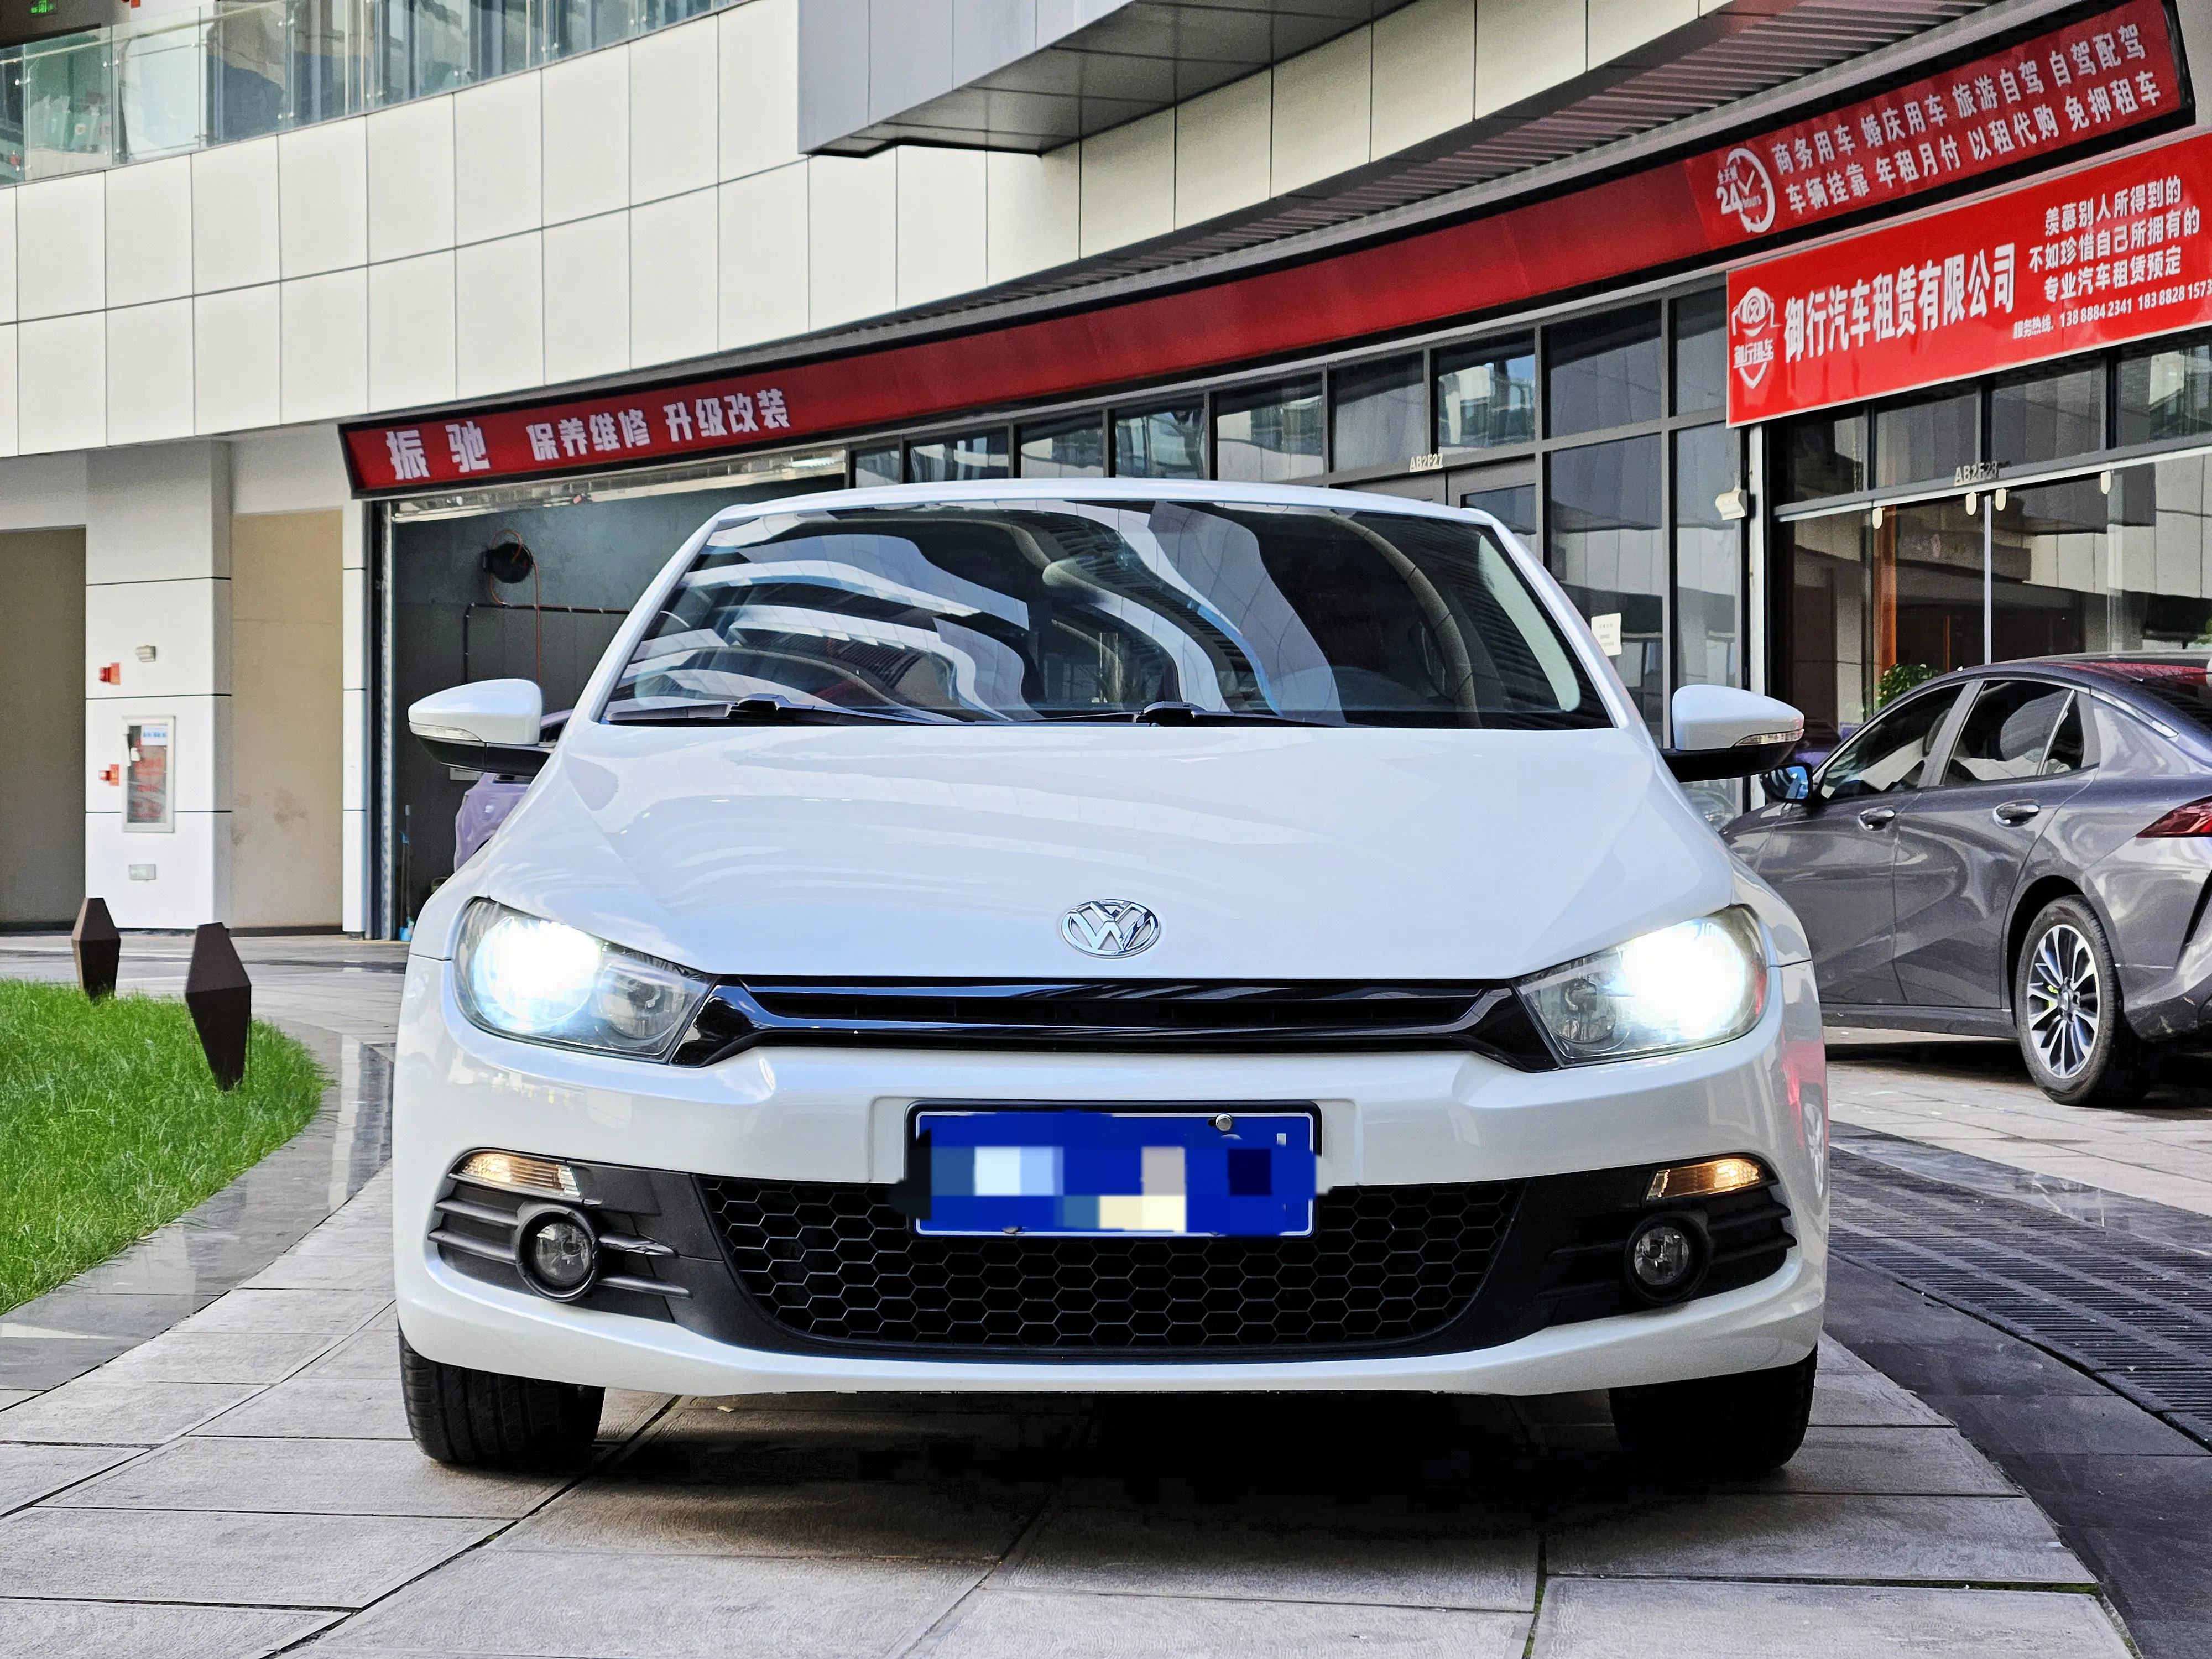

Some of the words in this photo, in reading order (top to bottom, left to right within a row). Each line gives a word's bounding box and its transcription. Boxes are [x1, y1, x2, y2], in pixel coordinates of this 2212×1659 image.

[1772, 124, 1855, 175] 商务用车
[1860, 95, 1947, 148] 婚庆用车
[1952, 60, 2044, 118] 旅游自驾
[2049, 24, 2146, 87] 自驾配驾
[1786, 163, 1870, 215] 车辆挂靠
[1876, 134, 1961, 189] 年租月付
[1967, 103, 2059, 160] 以租代购
[2065, 70, 2161, 132] 免押租车
[1716, 183, 1743, 215] 24
[2045, 175, 2181, 236] 羡慕别人所得到的
[2029, 205, 2200, 273] 不如珍惜自己所拥有的
[1784, 242, 2015, 363] 御行汽车租赁有限公司
[2044, 245, 2182, 302] 专业汽车租赁预定
[2059, 309, 2079, 327] 138
[2080, 303, 2105, 323] 8884
[2107, 298, 2132, 317] 2341
[2138, 291, 2157, 310] 183
[2159, 285, 2185, 306] 8828
[526, 409, 650, 461] 保养维修
[663, 388, 790, 442] 升级改装
